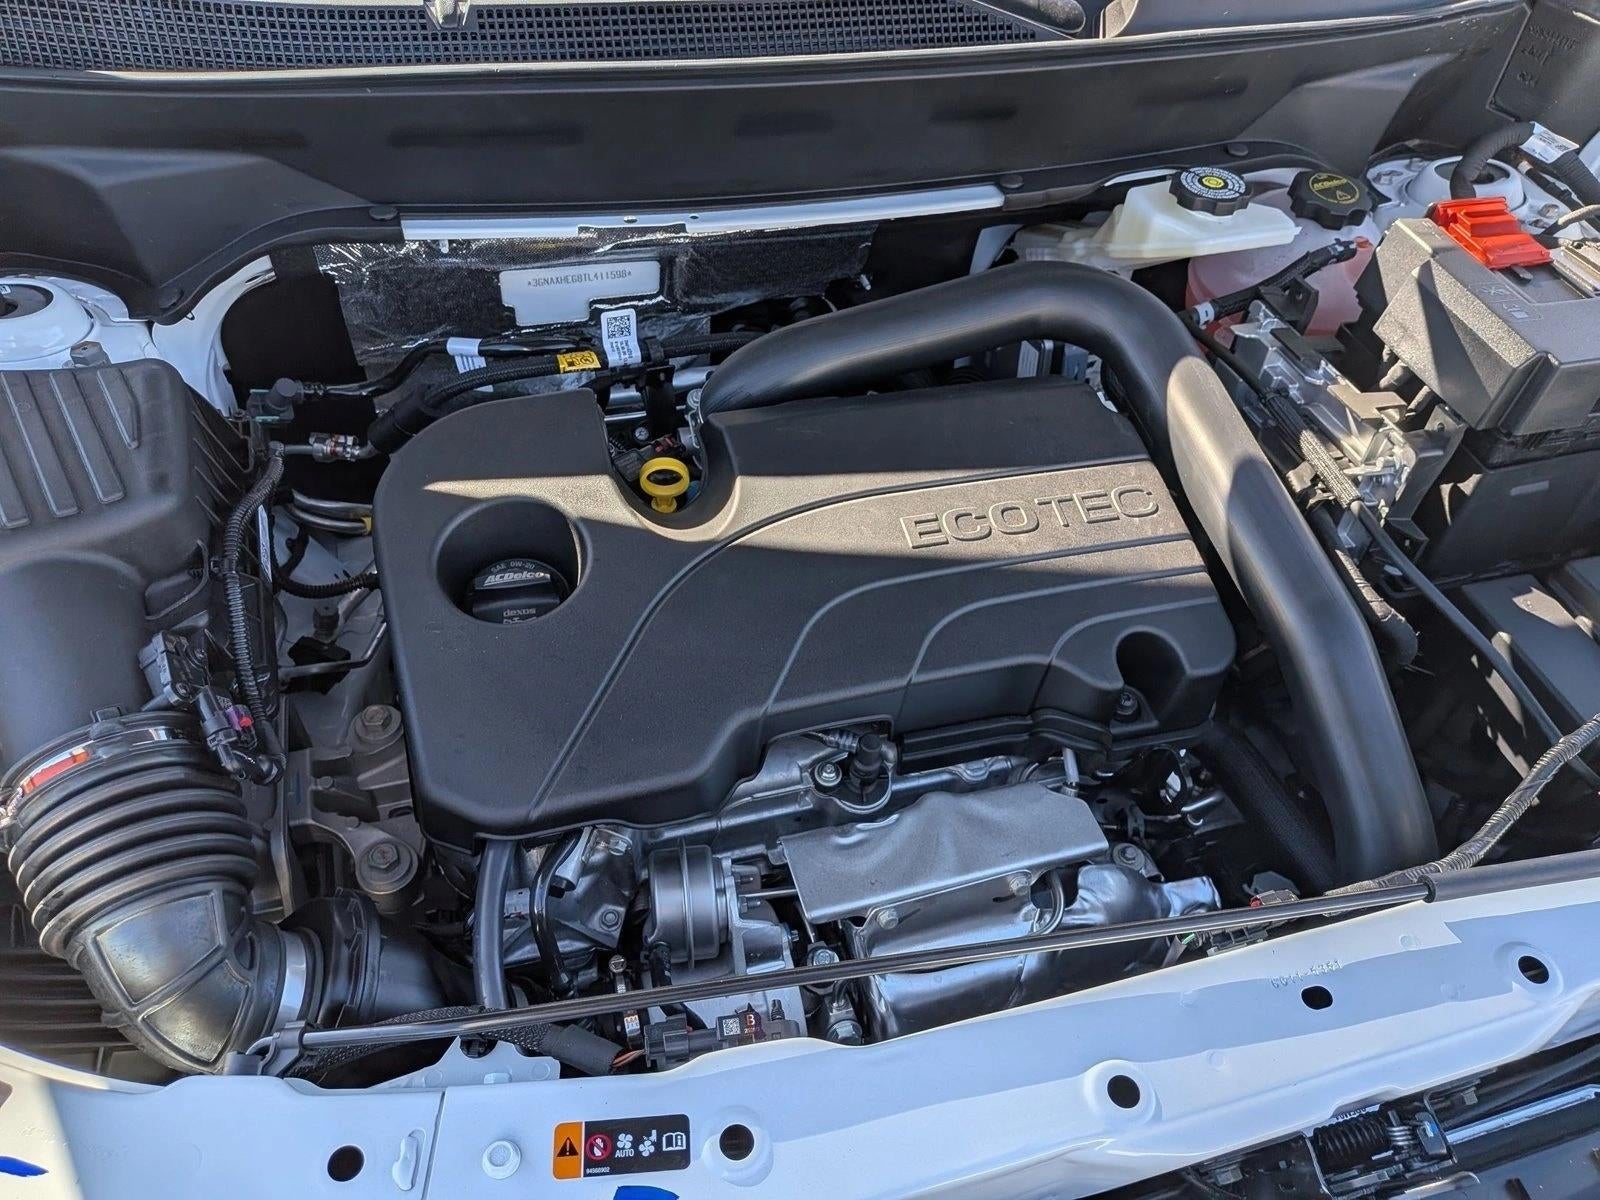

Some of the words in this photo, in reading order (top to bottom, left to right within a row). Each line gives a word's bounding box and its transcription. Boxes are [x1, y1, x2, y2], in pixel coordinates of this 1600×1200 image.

[899, 484, 1160, 550] ECOTEC
[483, 571, 545, 585] ACDelco
[615, 1148, 635, 1158] AUTO
